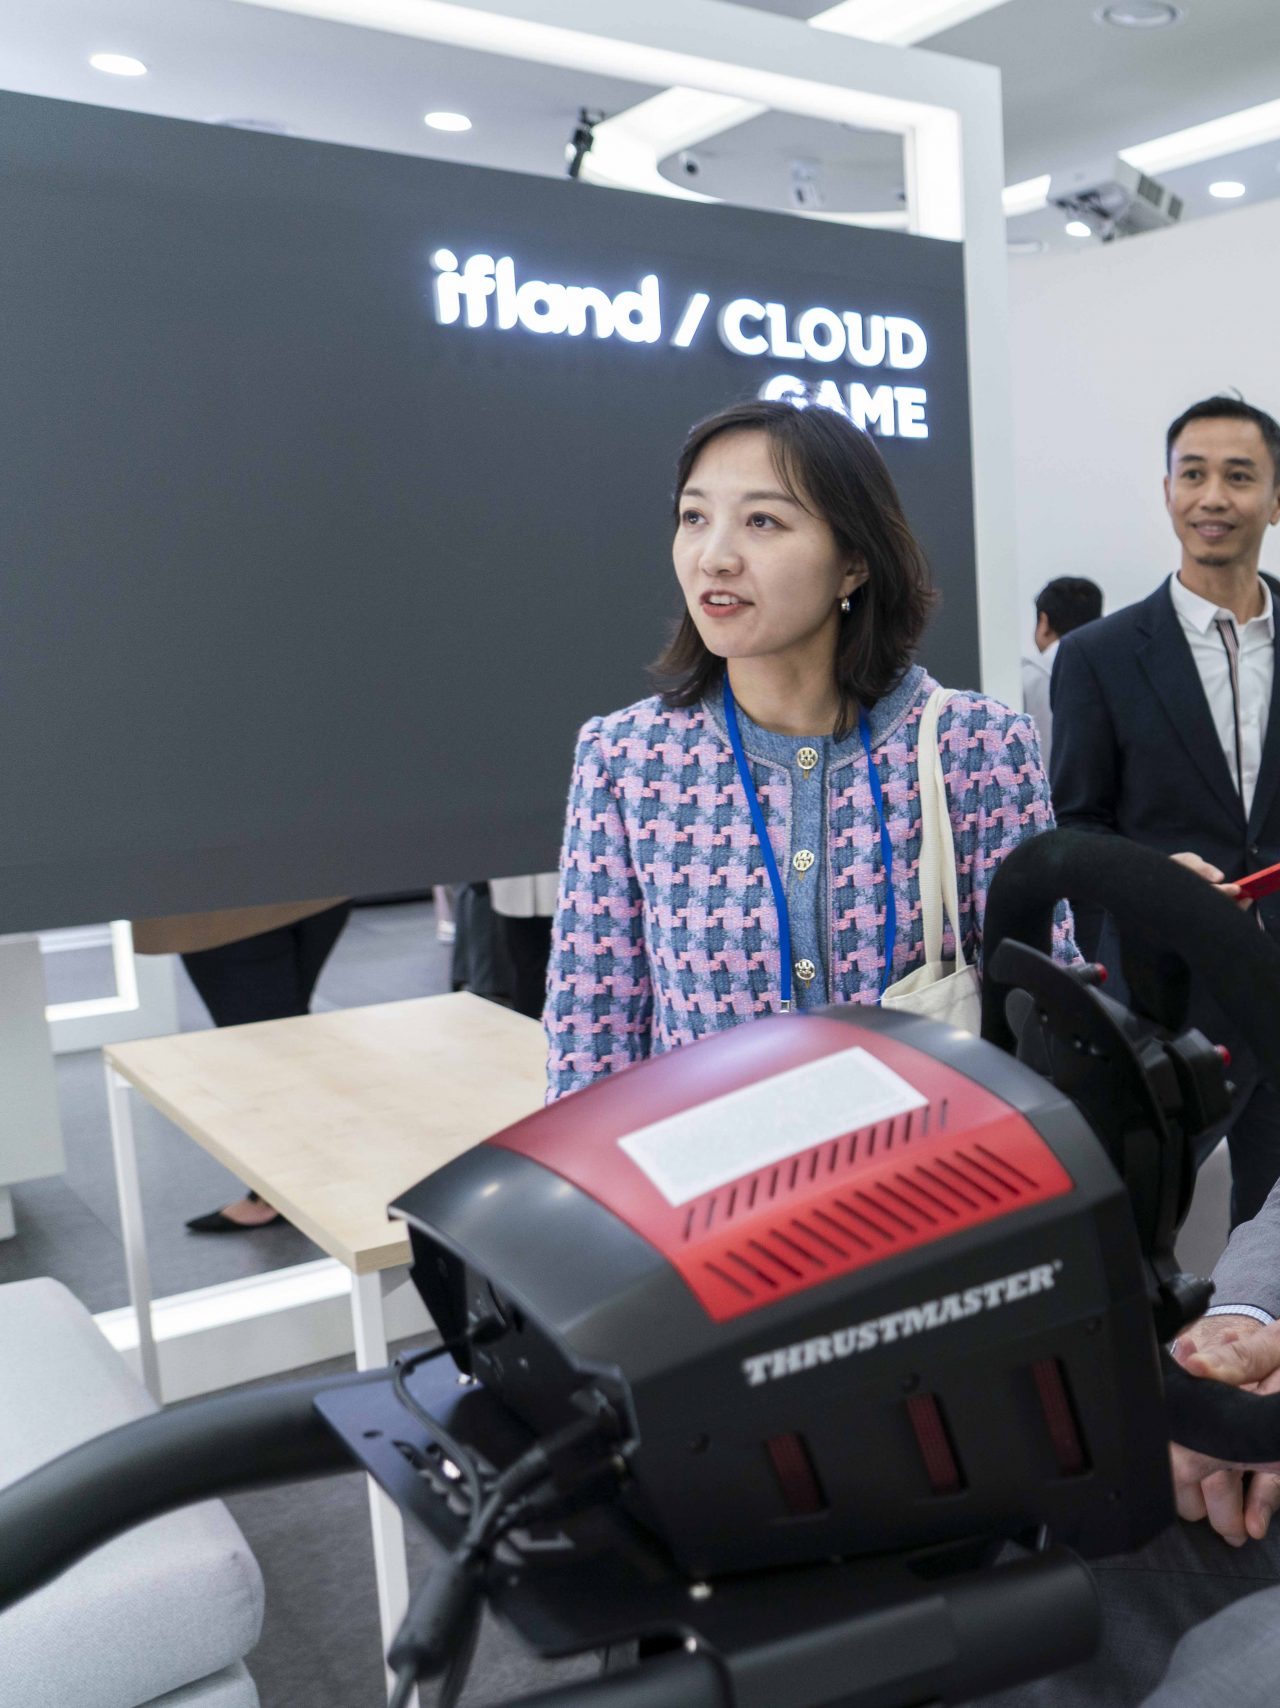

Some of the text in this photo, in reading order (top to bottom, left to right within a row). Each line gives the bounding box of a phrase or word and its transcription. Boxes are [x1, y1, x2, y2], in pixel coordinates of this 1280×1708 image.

[431, 249, 662, 344] ifland
[718, 298, 928, 370] CLOUD
[759, 374, 929, 438] GAME
[742, 1262, 1057, 1387] THRUSTMASTER
